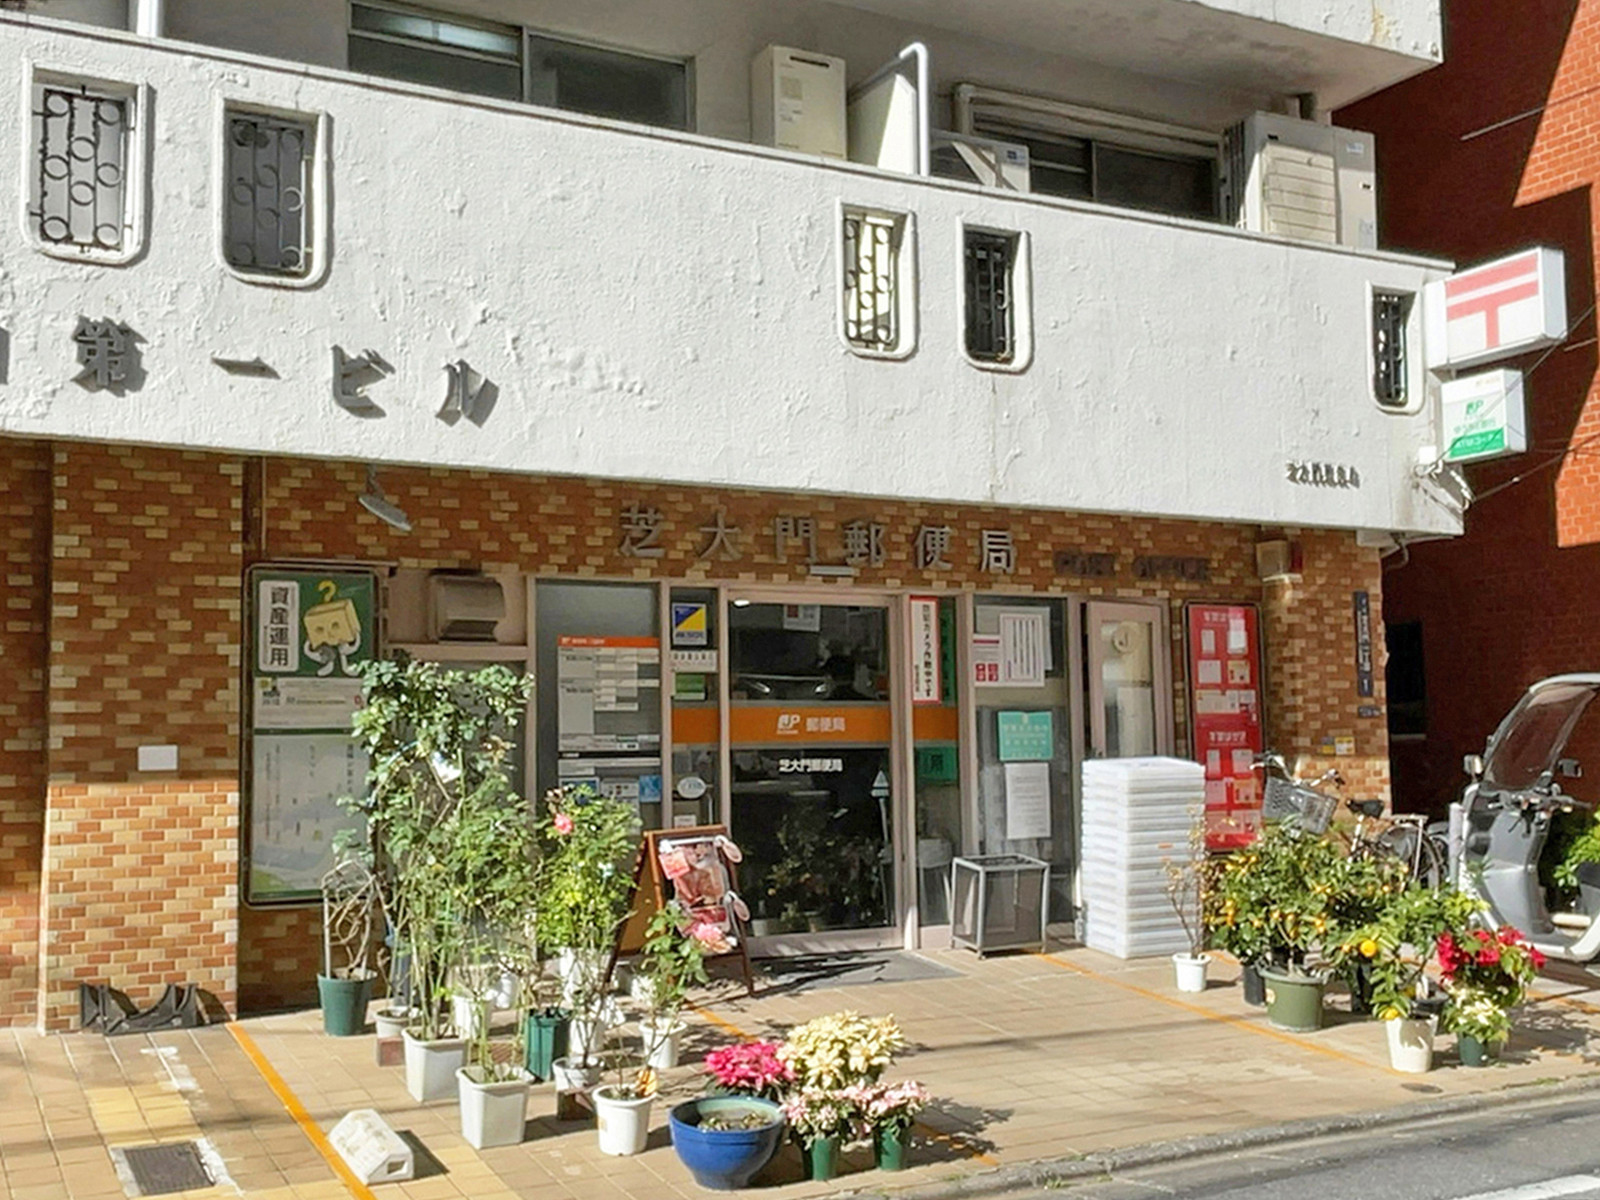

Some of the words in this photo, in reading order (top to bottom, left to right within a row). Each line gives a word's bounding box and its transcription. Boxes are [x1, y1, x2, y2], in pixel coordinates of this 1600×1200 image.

[0, 315, 499, 427] 第一ビル
[619, 503, 1017, 573] 芝大門郵便局
[269, 586, 289, 667] 資産運用
